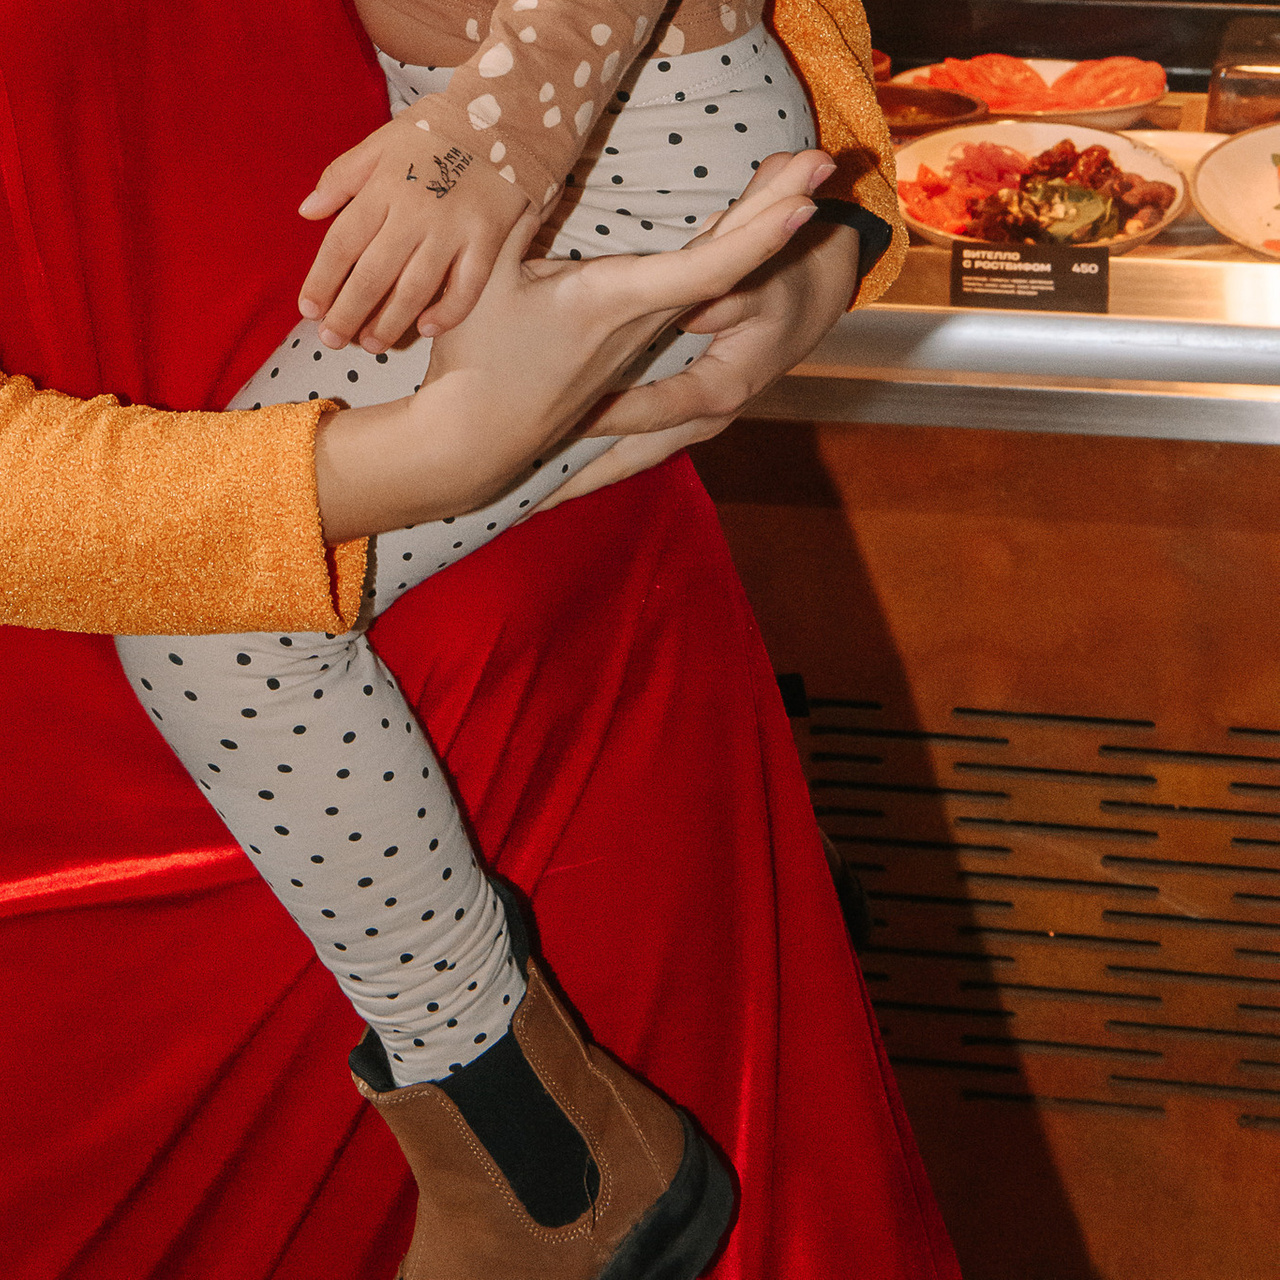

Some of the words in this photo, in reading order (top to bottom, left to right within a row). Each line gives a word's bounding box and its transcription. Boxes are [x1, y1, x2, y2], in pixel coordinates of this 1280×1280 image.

[962, 248, 1021, 262] ВИТЕЛЛО
[973, 260, 1052, 273] РОСТБИФОМ
[1071, 262, 1100, 275] 450
